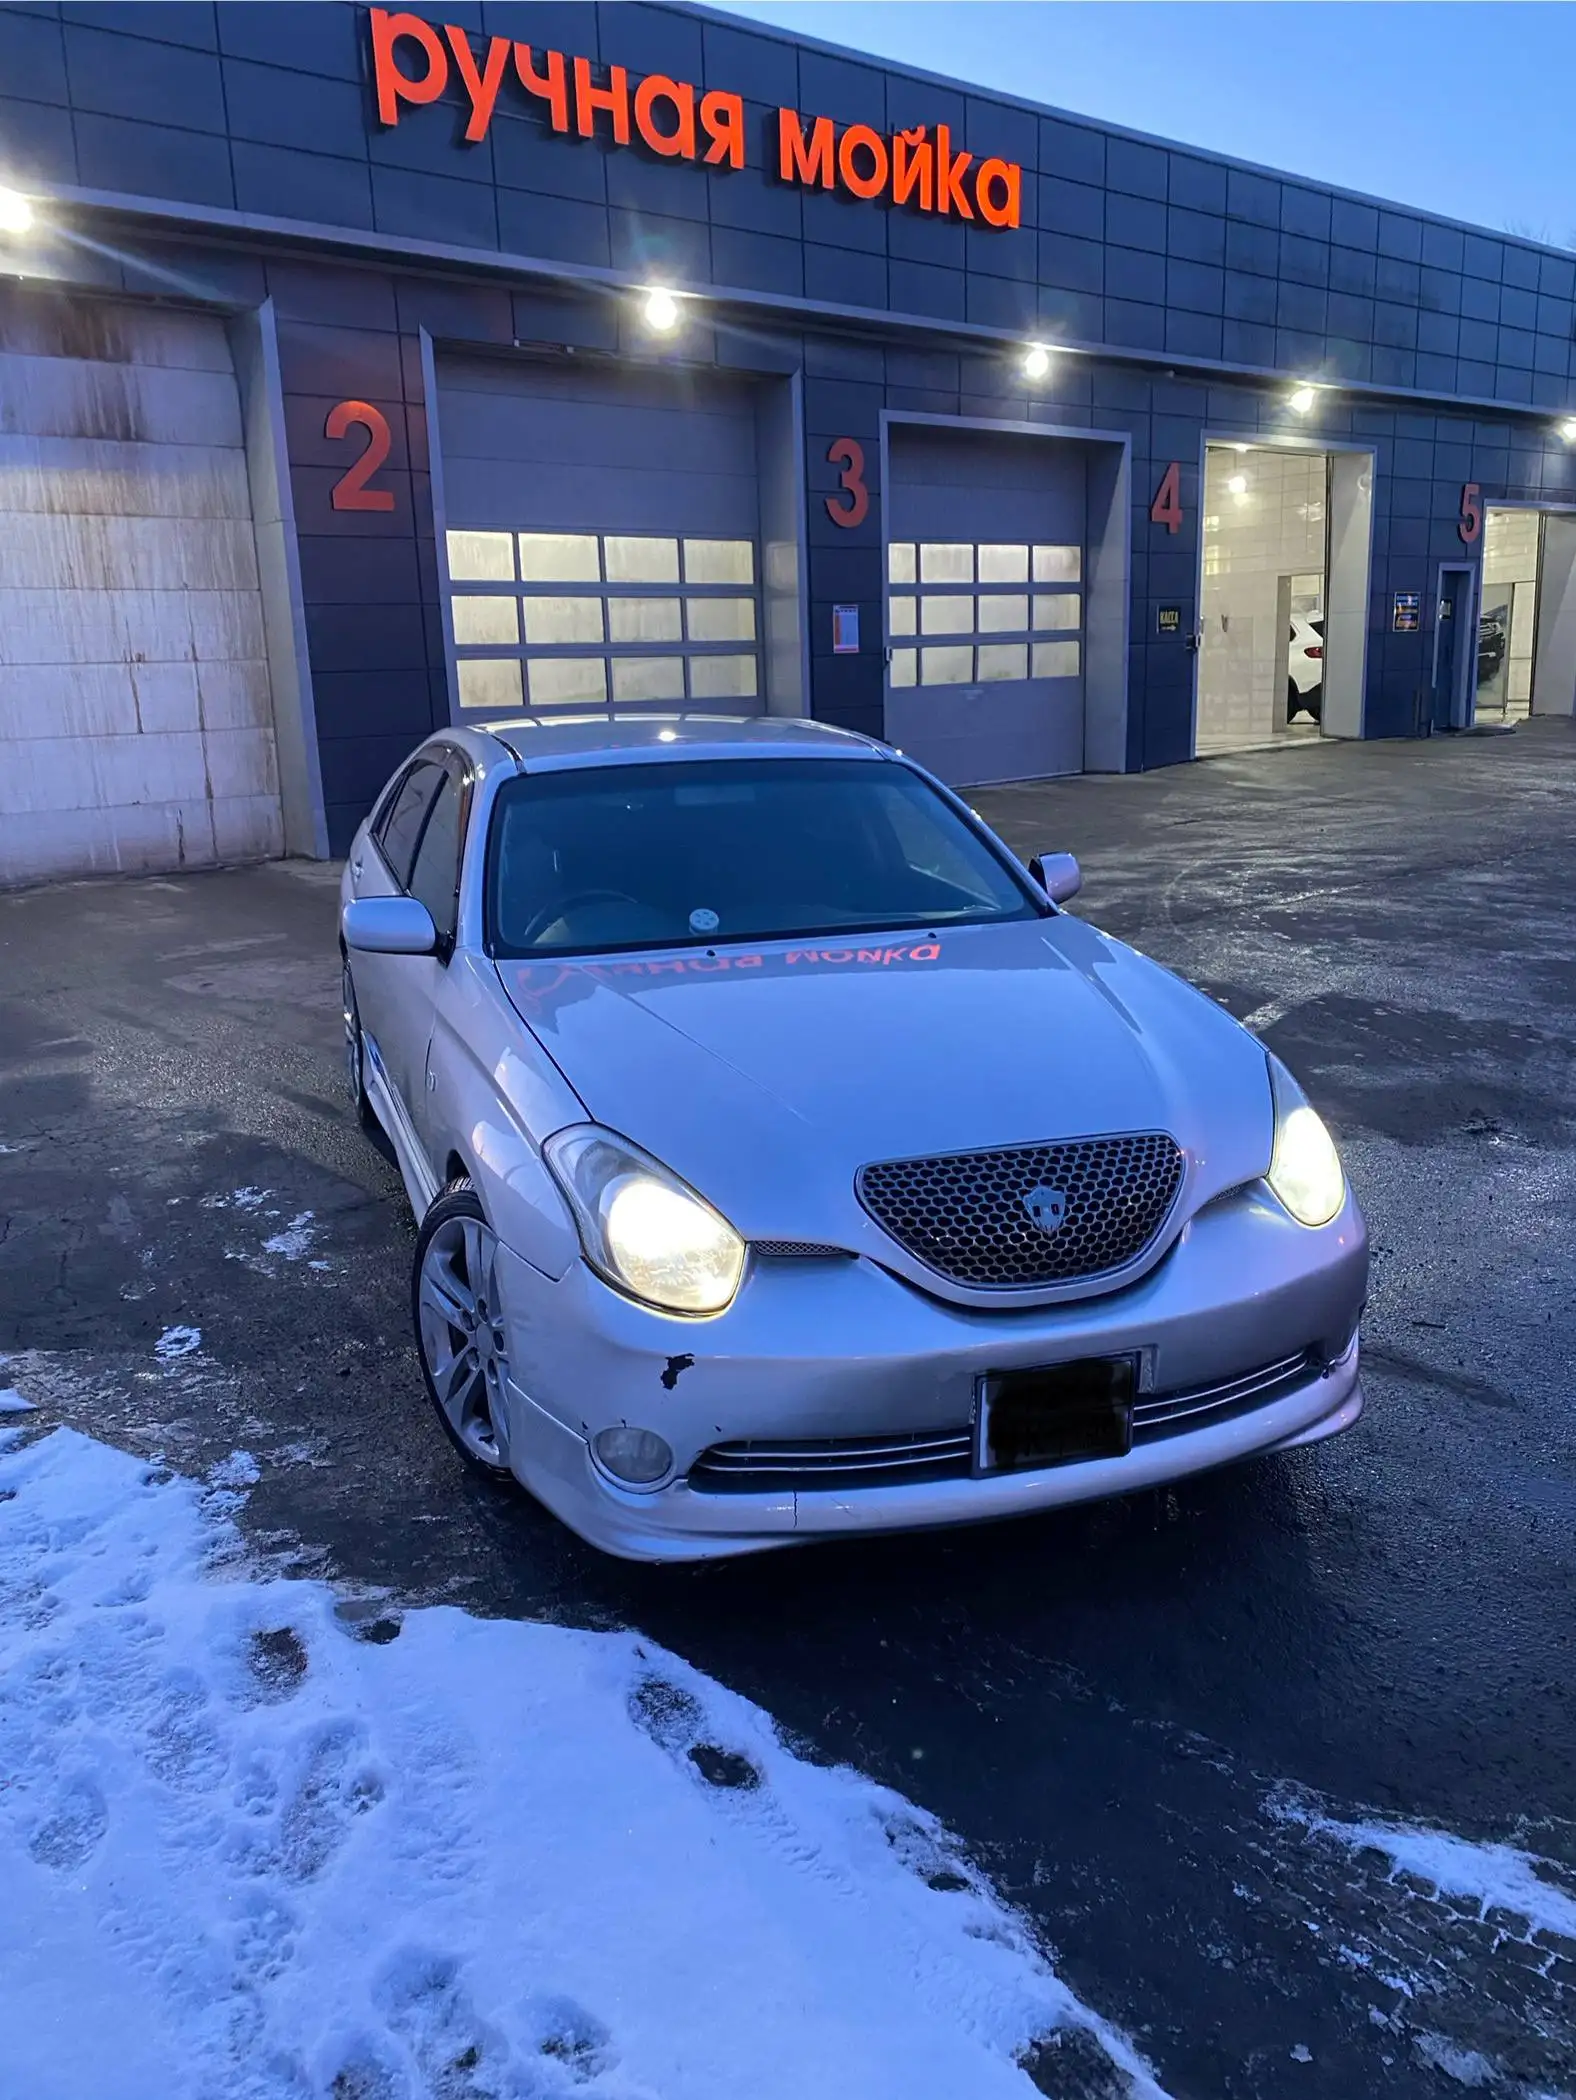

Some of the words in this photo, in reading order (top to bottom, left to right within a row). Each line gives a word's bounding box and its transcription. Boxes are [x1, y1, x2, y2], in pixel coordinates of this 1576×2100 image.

[369, 7, 745, 169] ручная
[779, 107, 1021, 229] мойка
[325, 400, 395, 512] 2
[825, 438, 869, 528] 3
[1151, 461, 1183, 534] 4
[1459, 483, 1481, 543] 5
